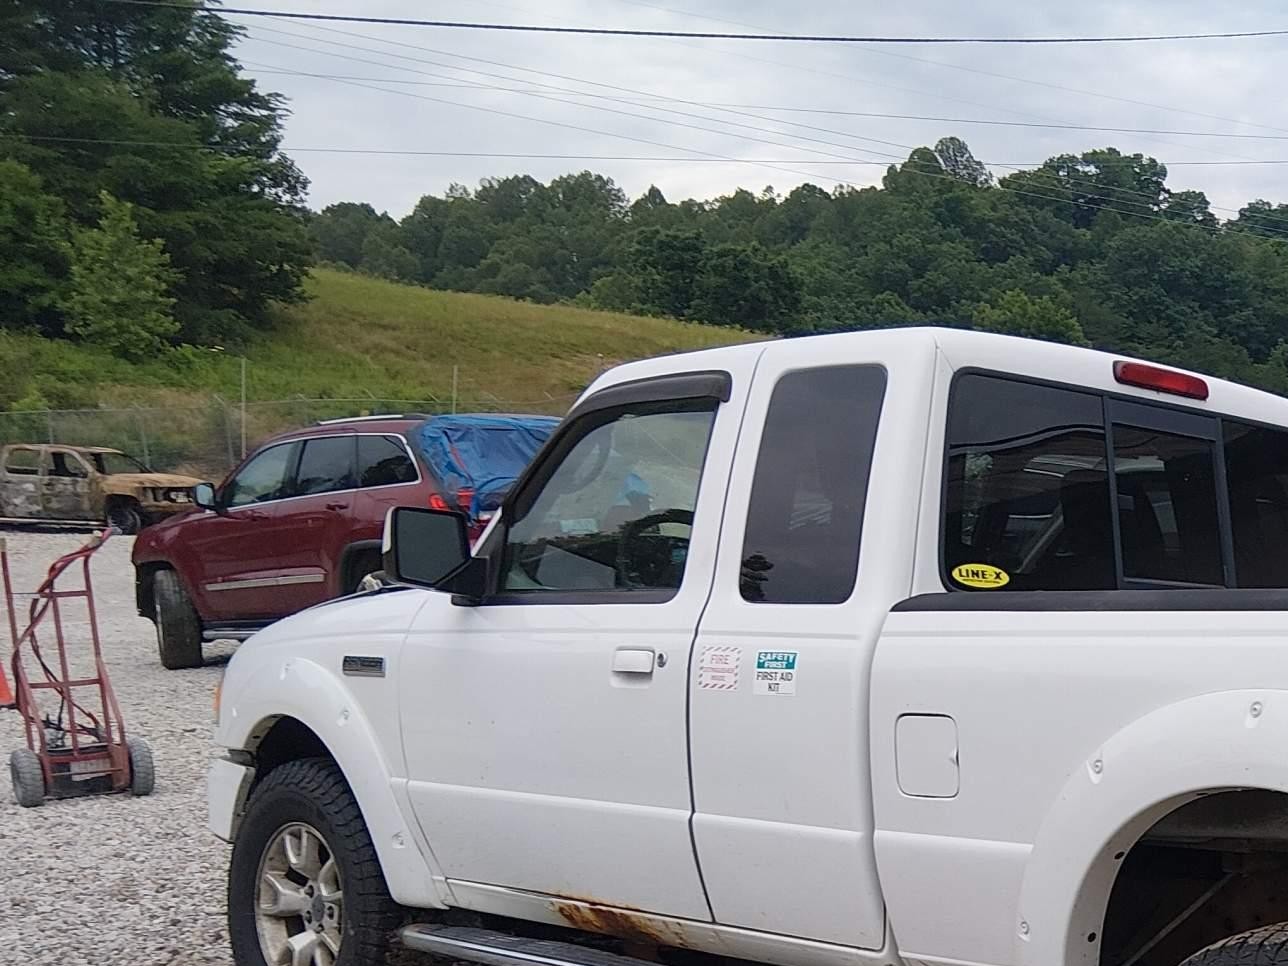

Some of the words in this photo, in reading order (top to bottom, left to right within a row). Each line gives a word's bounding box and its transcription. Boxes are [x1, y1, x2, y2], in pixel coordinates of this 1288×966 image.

[958, 568, 1003, 581] LINE-X
[759, 653, 796, 663] SAFETY
[756, 672, 777, 681] FIRST
[780, 672, 793, 681] AID
[768, 683, 780, 692] KIT
